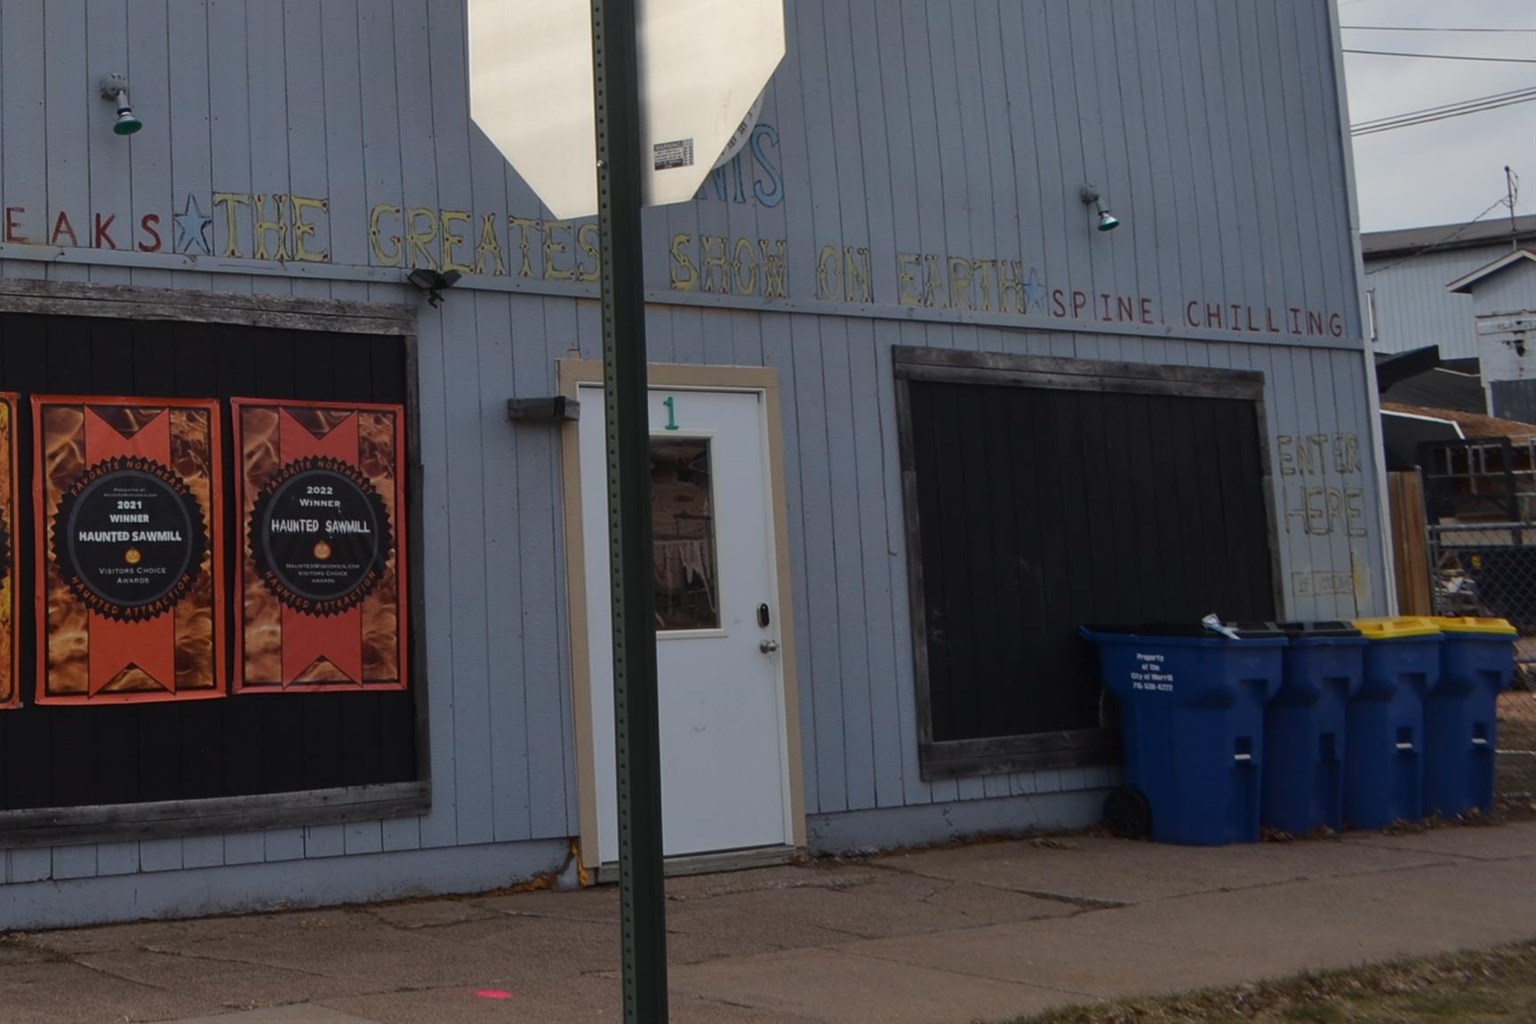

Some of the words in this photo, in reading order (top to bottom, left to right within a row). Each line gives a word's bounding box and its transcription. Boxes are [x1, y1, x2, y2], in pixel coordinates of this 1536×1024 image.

[212, 191, 331, 263] THE
[369, 204, 600, 281] GREATES
[670, 233, 788, 300] SHOW
[817, 245, 873, 304] ON
[896, 253, 1026, 314] EARTH
[1052, 289, 1154, 324] SPINE
[1186, 300, 1344, 338] CHILLING
[662, 395, 681, 432] 1
[1276, 432, 1363, 476] ENTER
[71, 460, 120, 497] FAVORITE
[126, 461, 188, 497] NORTHEAST
[306, 486, 334, 495] 2022
[109, 514, 150, 523] WINNER
[117, 501, 143, 509] 2021
[1282, 485, 1368, 538] HERE
[79, 531, 130, 542] HAUNTED
[132, 531, 182, 542] SAWMILL
[271, 519, 319, 532] HAUNTED
[325, 520, 371, 533] SAWMILL
[71, 576, 119, 614] HAUNTED
[125, 574, 190, 616] ATTRACTION
[266, 570, 310, 608] HAUNTED
[315, 570, 377, 610] ATTRACTION
[1137, 653, 1164, 662] Property
